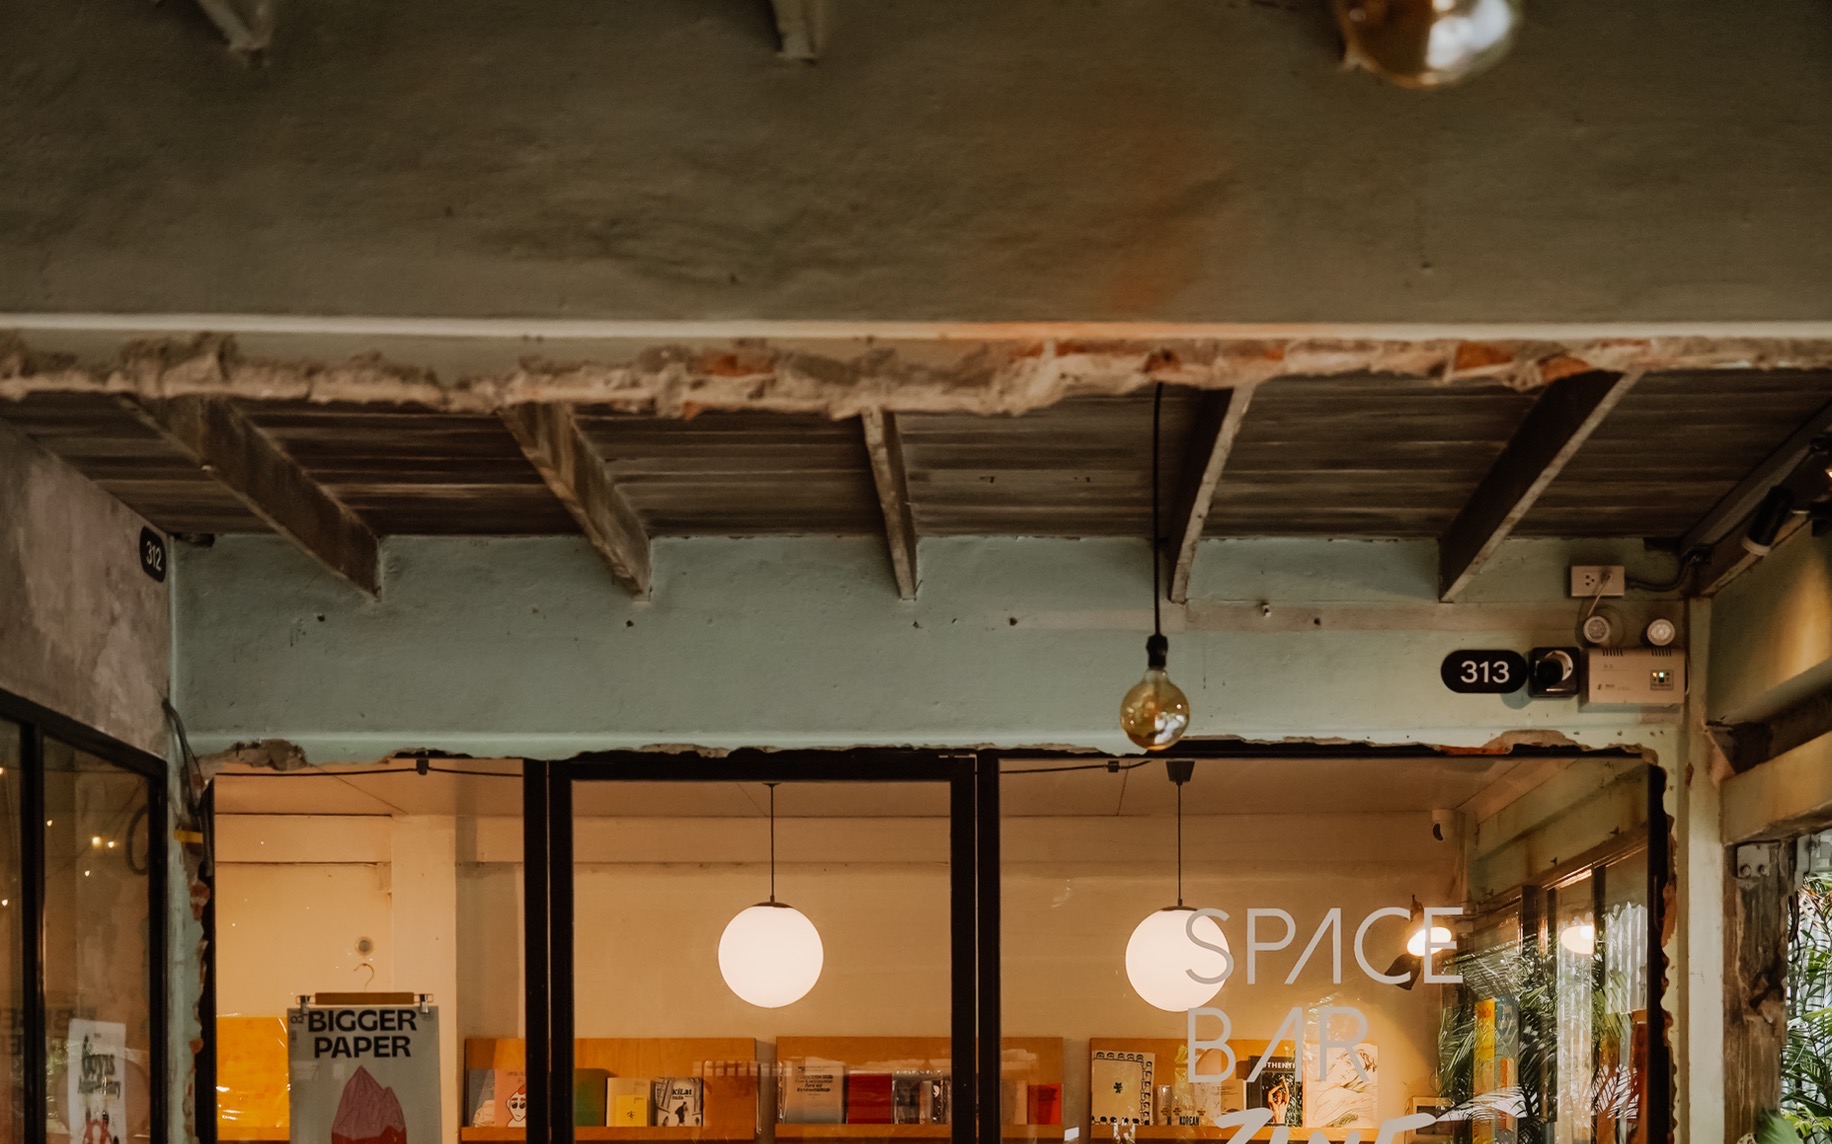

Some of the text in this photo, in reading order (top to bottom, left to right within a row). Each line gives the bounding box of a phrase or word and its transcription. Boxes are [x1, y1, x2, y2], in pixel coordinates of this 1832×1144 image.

[146, 540, 162, 571] 312
[1460, 660, 1510, 683] 313
[1184, 906, 1464, 985] SPACE
[308, 1009, 417, 1032] BIGGER
[314, 1036, 411, 1059] PAPER
[1187, 1006, 1369, 1083] BAR
